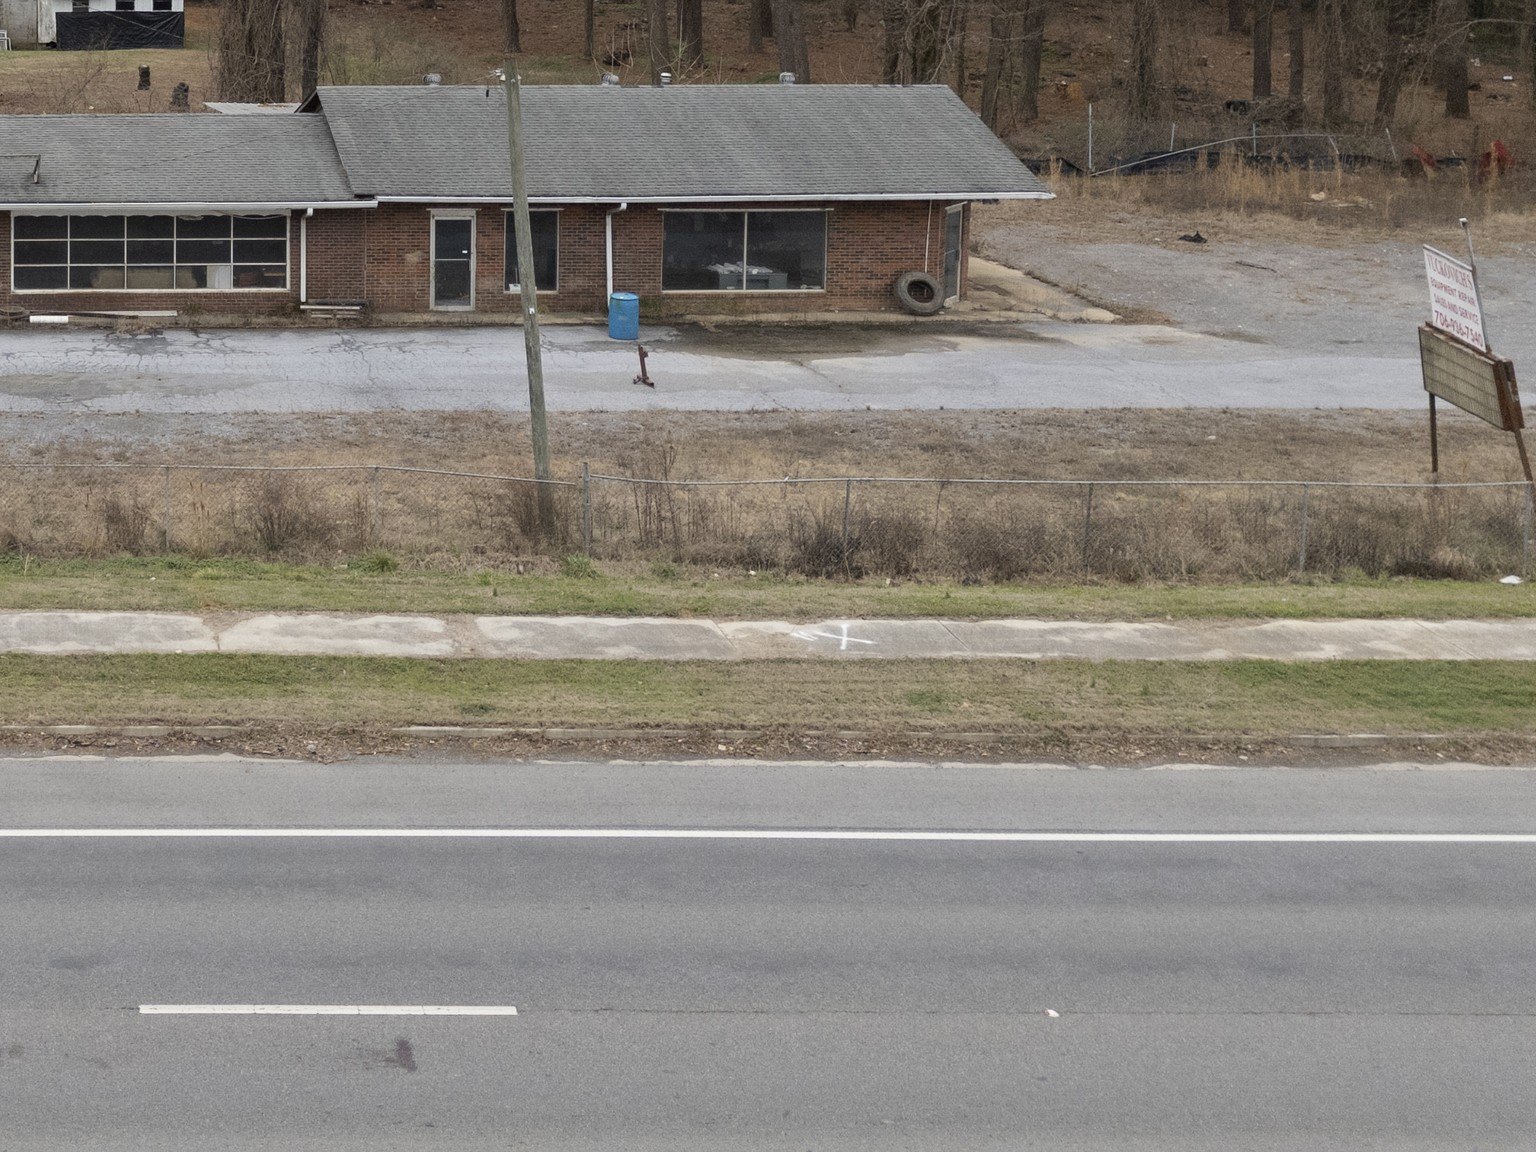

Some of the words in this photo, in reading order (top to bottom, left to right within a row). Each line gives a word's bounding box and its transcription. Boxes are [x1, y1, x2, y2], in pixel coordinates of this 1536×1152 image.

[1430, 276, 1457, 297] EQUIPMENT
[1458, 290, 1476, 307] REPAIR
[1459, 306, 1479, 325] SERVICE
